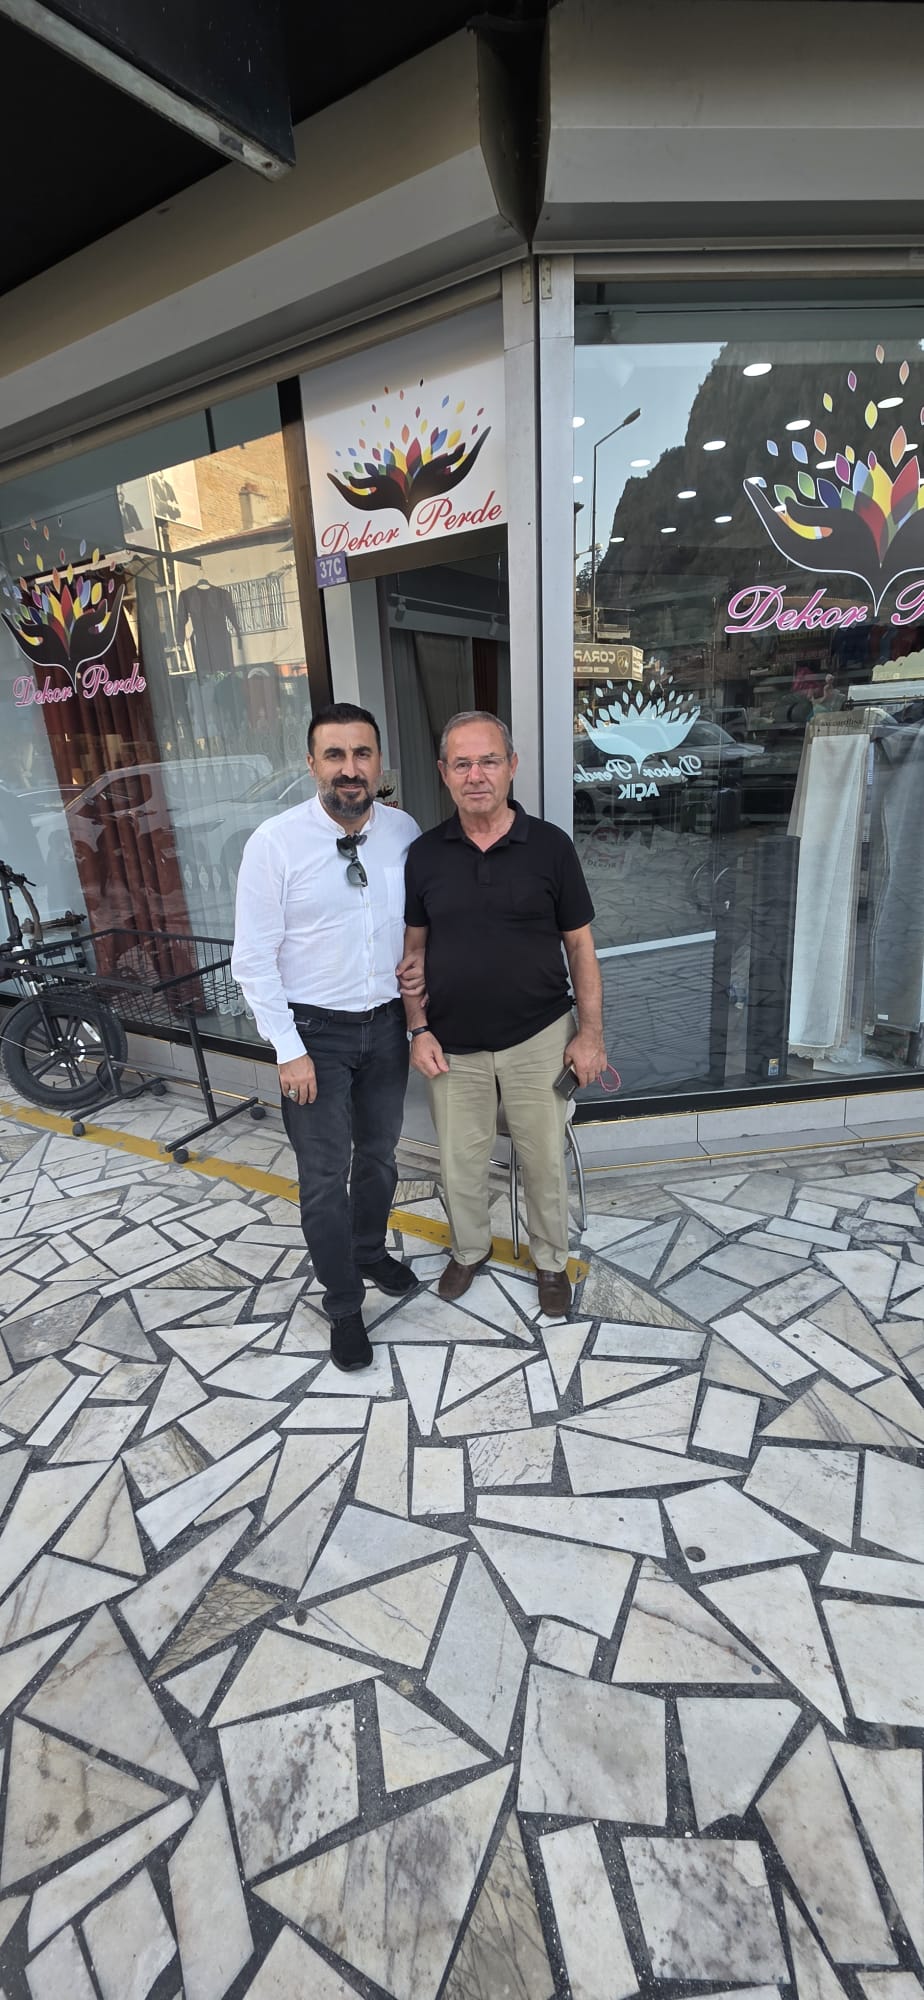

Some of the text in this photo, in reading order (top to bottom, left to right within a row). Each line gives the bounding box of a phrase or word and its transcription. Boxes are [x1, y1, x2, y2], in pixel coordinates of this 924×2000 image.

[321, 490, 502, 557] Dekor Perde
[319, 557, 342, 579] 37C
[724, 585, 868, 634] Dekor
[13, 662, 147, 707] Dekor Perde
